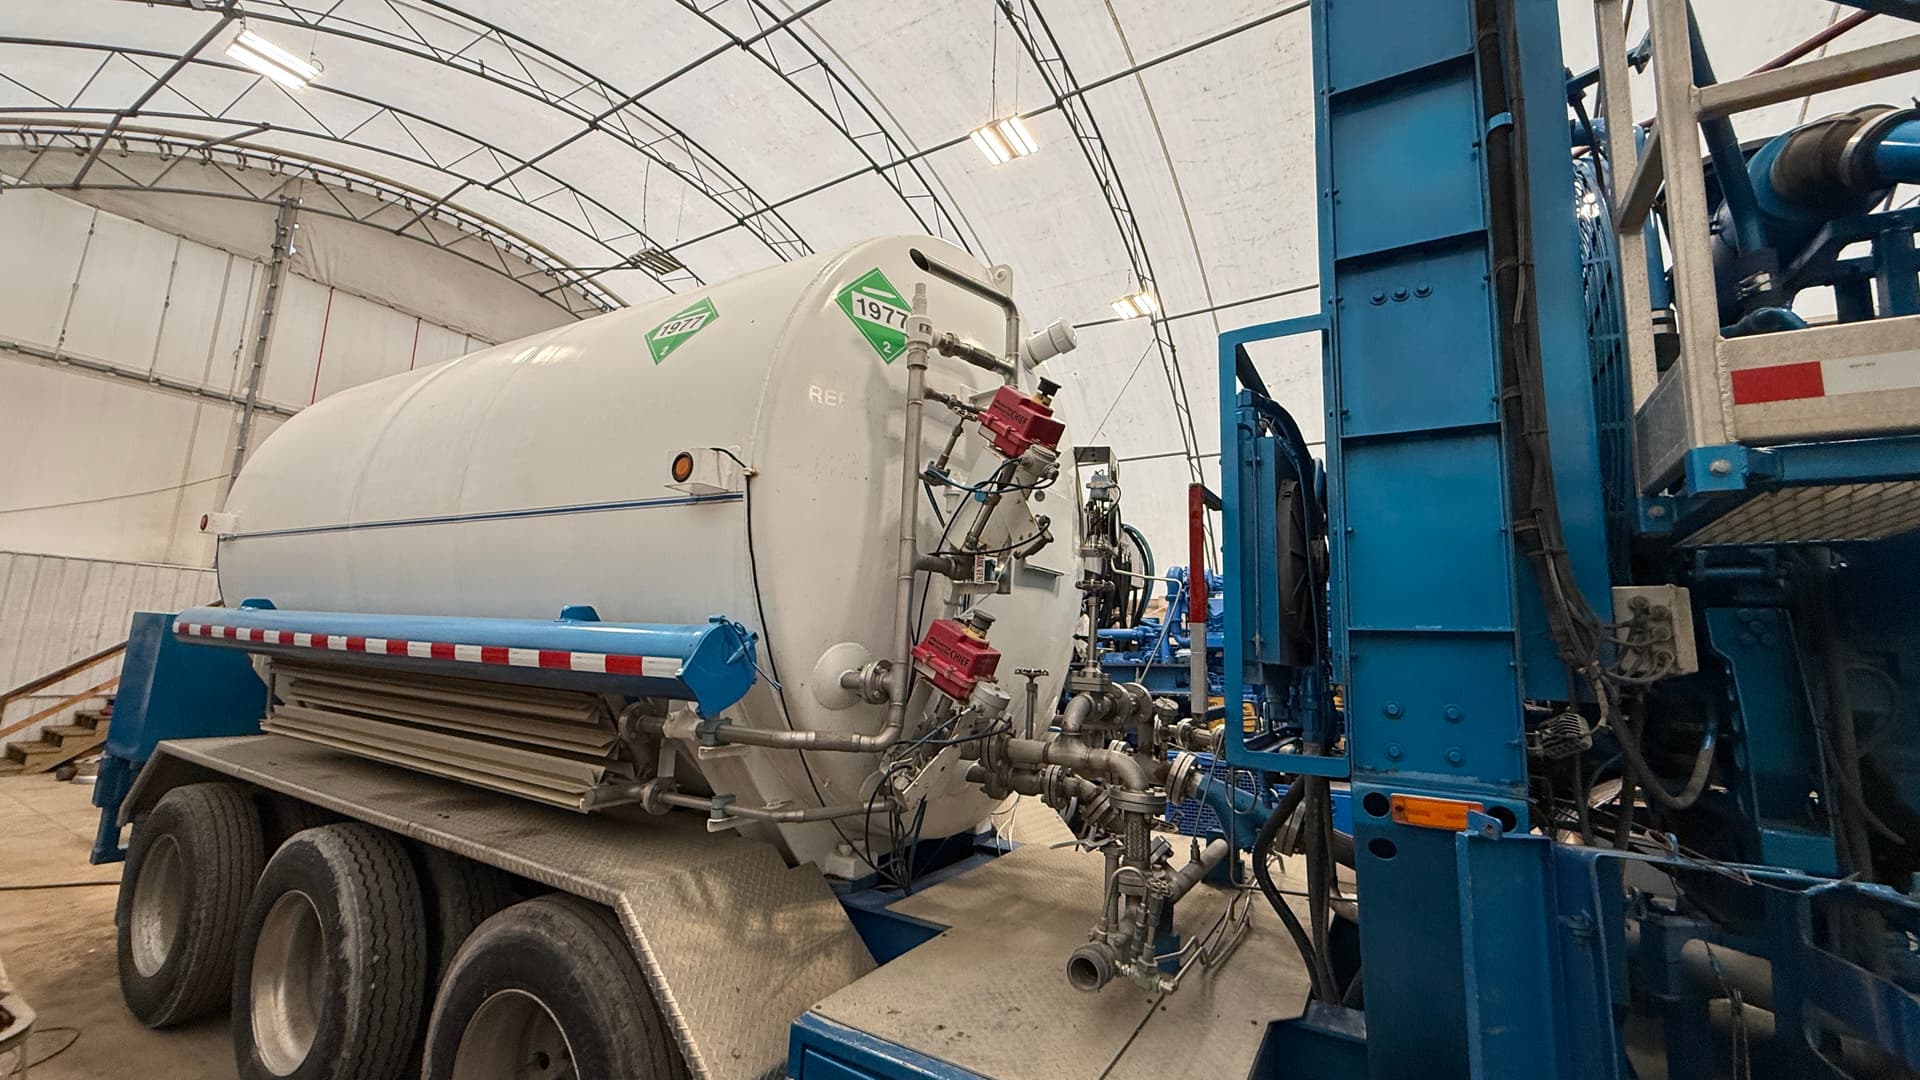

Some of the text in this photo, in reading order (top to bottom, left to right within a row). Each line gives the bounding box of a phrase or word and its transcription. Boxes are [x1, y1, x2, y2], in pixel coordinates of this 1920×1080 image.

[857, 297, 908, 329] 1977
[660, 315, 705, 337] 1977
[883, 341, 892, 354] 2
[950, 650, 969, 666] CHIEF
